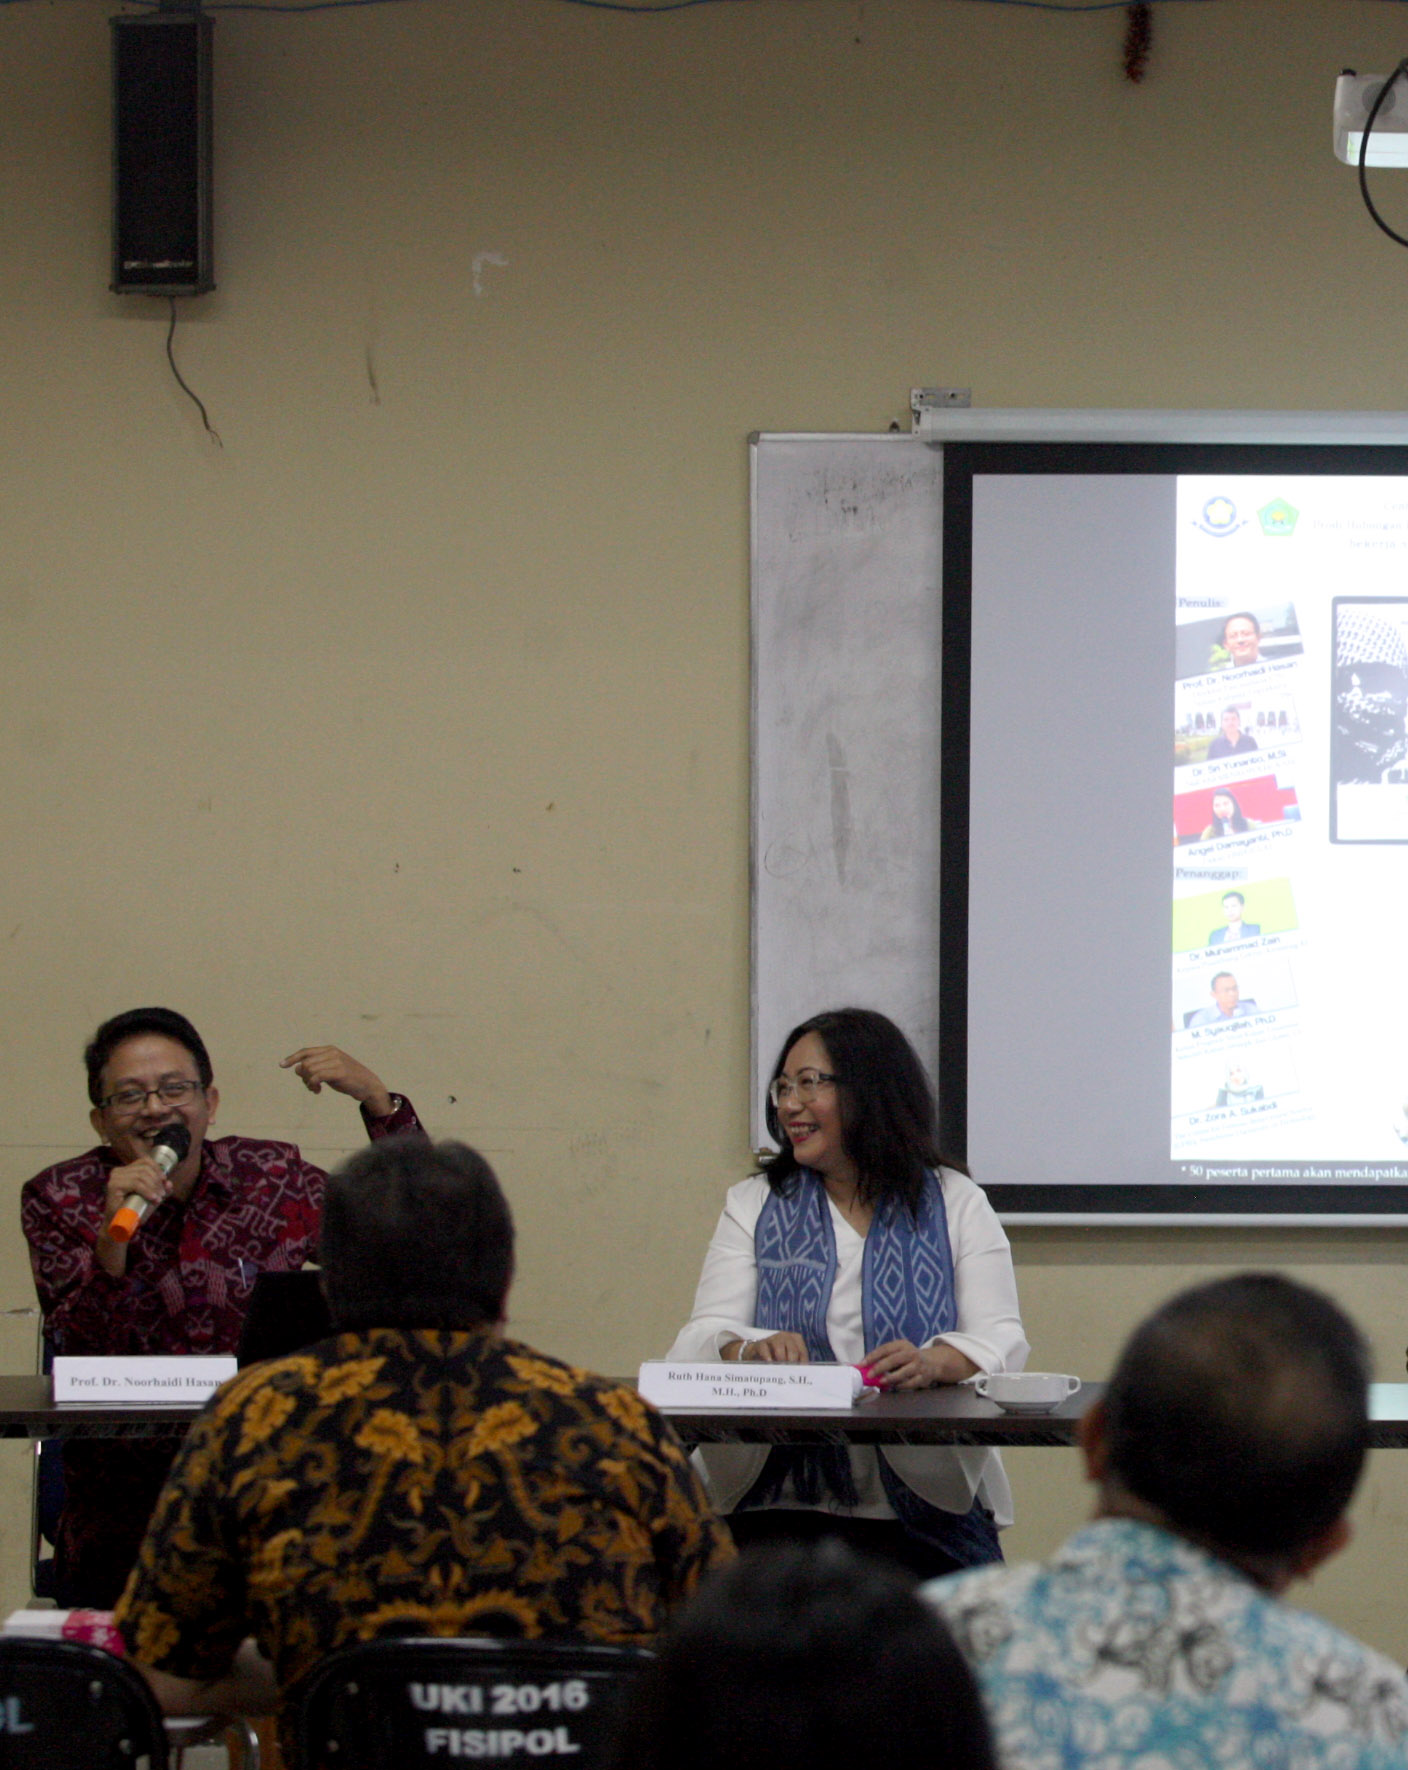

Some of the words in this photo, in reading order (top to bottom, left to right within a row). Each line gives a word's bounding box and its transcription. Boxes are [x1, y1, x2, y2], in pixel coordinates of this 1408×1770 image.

[1206, 1167, 1249, 1181] peserta
[1252, 1167, 1300, 1181] pertama
[1302, 1165, 1332, 1179] akan
[69, 1376, 99, 1387] Prof.
[102, 1376, 122, 1387] Dr.
[124, 1376, 183, 1387] Noorhaidi
[667, 1371, 693, 1381] Ruth
[695, 1372, 722, 1382] Hana
[724, 1373, 787, 1385] Simatupang,
[743, 1387, 768, 1398] Ph.D
[407, 1682, 484, 1715] UKI
[490, 1678, 591, 1715] 2016
[424, 1725, 582, 1759] FISIPOL
